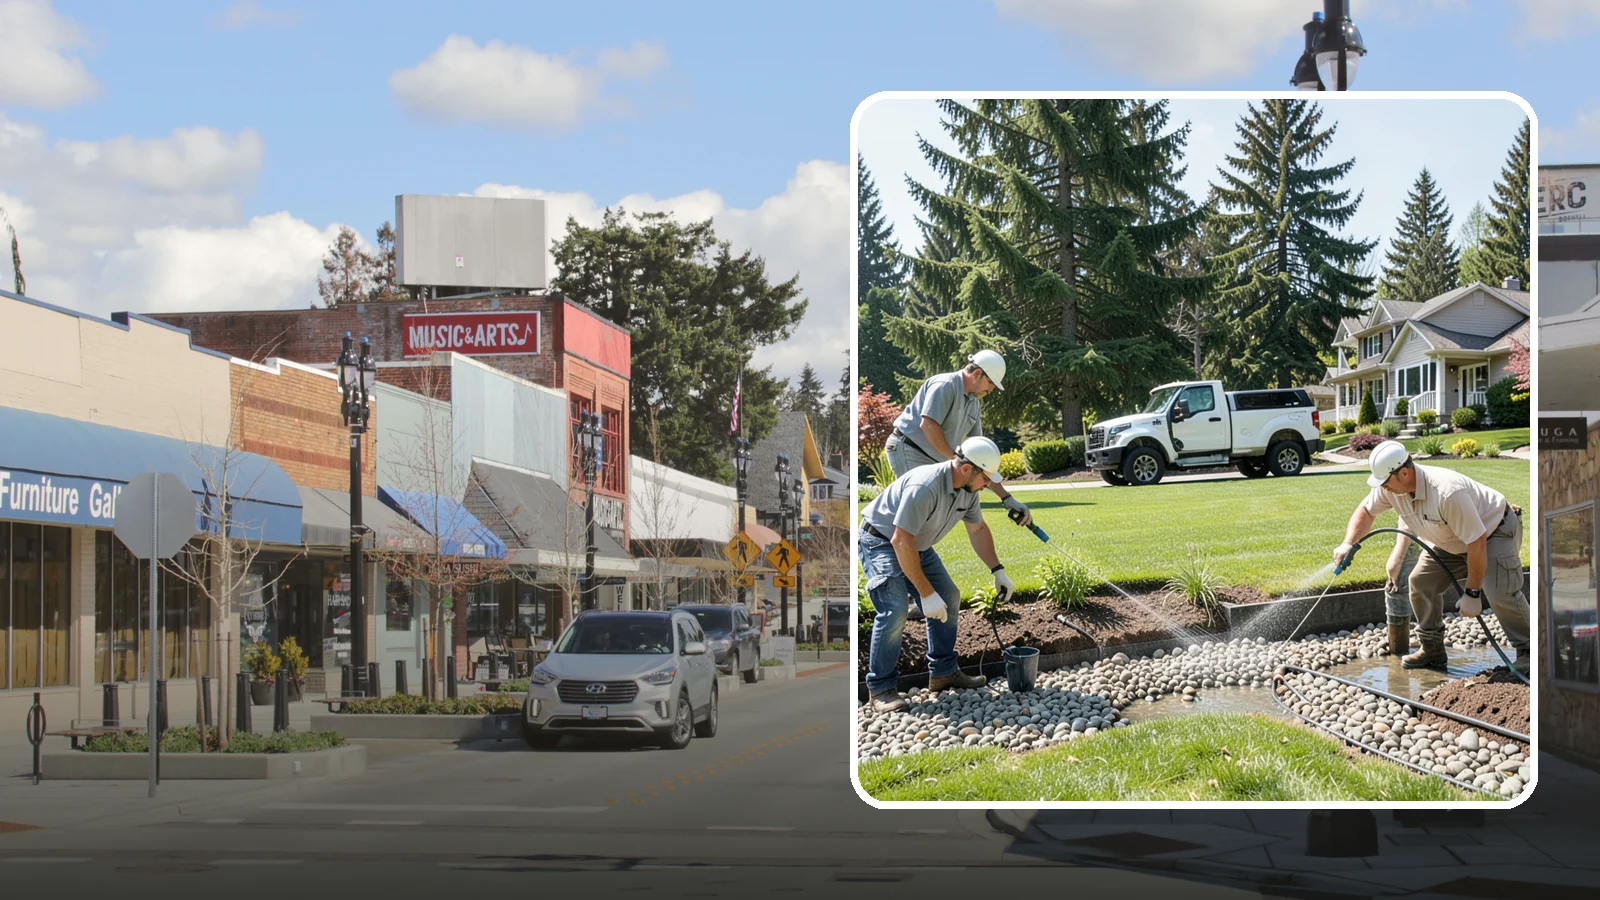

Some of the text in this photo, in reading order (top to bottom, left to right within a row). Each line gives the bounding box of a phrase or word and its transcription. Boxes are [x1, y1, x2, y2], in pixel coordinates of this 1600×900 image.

[1540, 427, 1577, 437] UGA
[0, 471, 79, 515] Furniture
[452, 562, 480, 574] SUSHI
